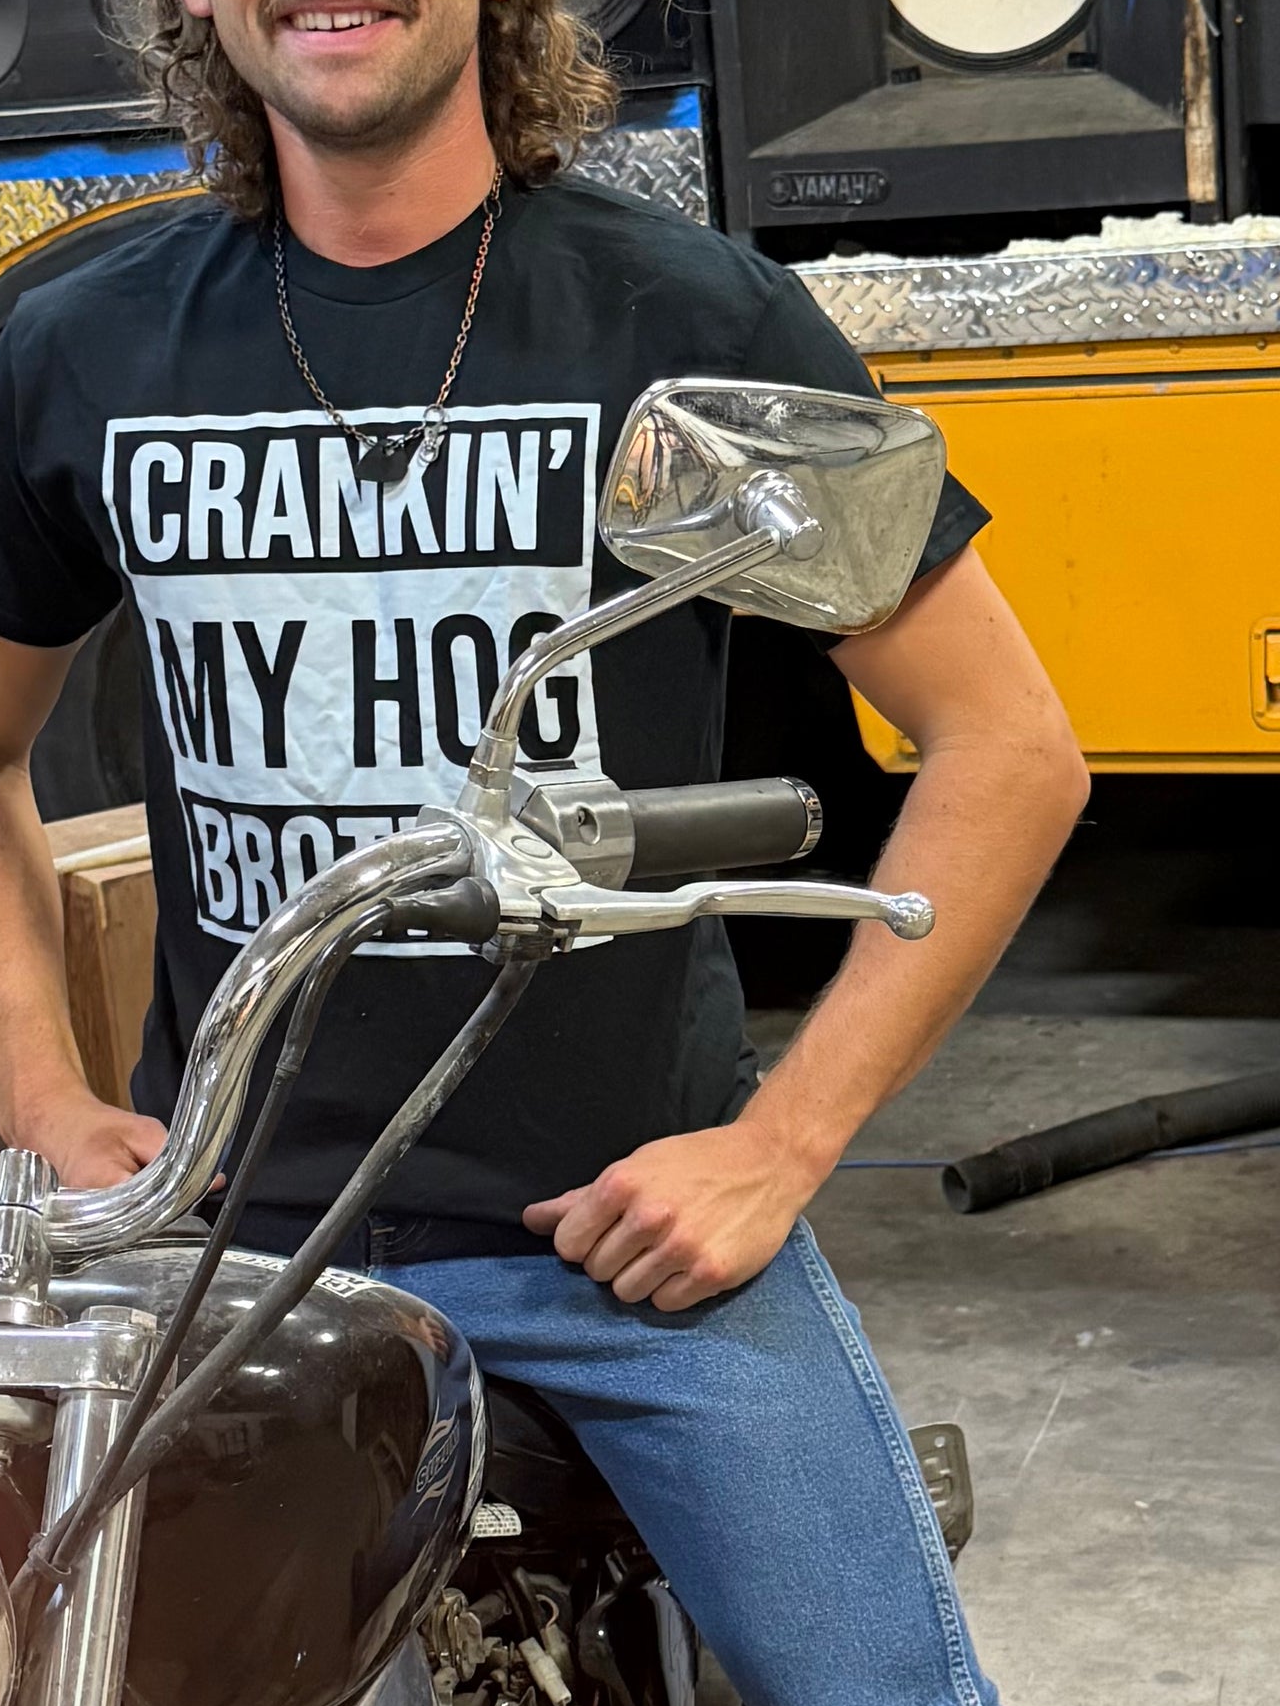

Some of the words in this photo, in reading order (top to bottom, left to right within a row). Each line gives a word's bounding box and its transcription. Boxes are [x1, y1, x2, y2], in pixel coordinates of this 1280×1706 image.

[793, 174, 880, 200] YAMAHA
[156, 617, 308, 768] MY
[350, 610, 581, 768] HOG
